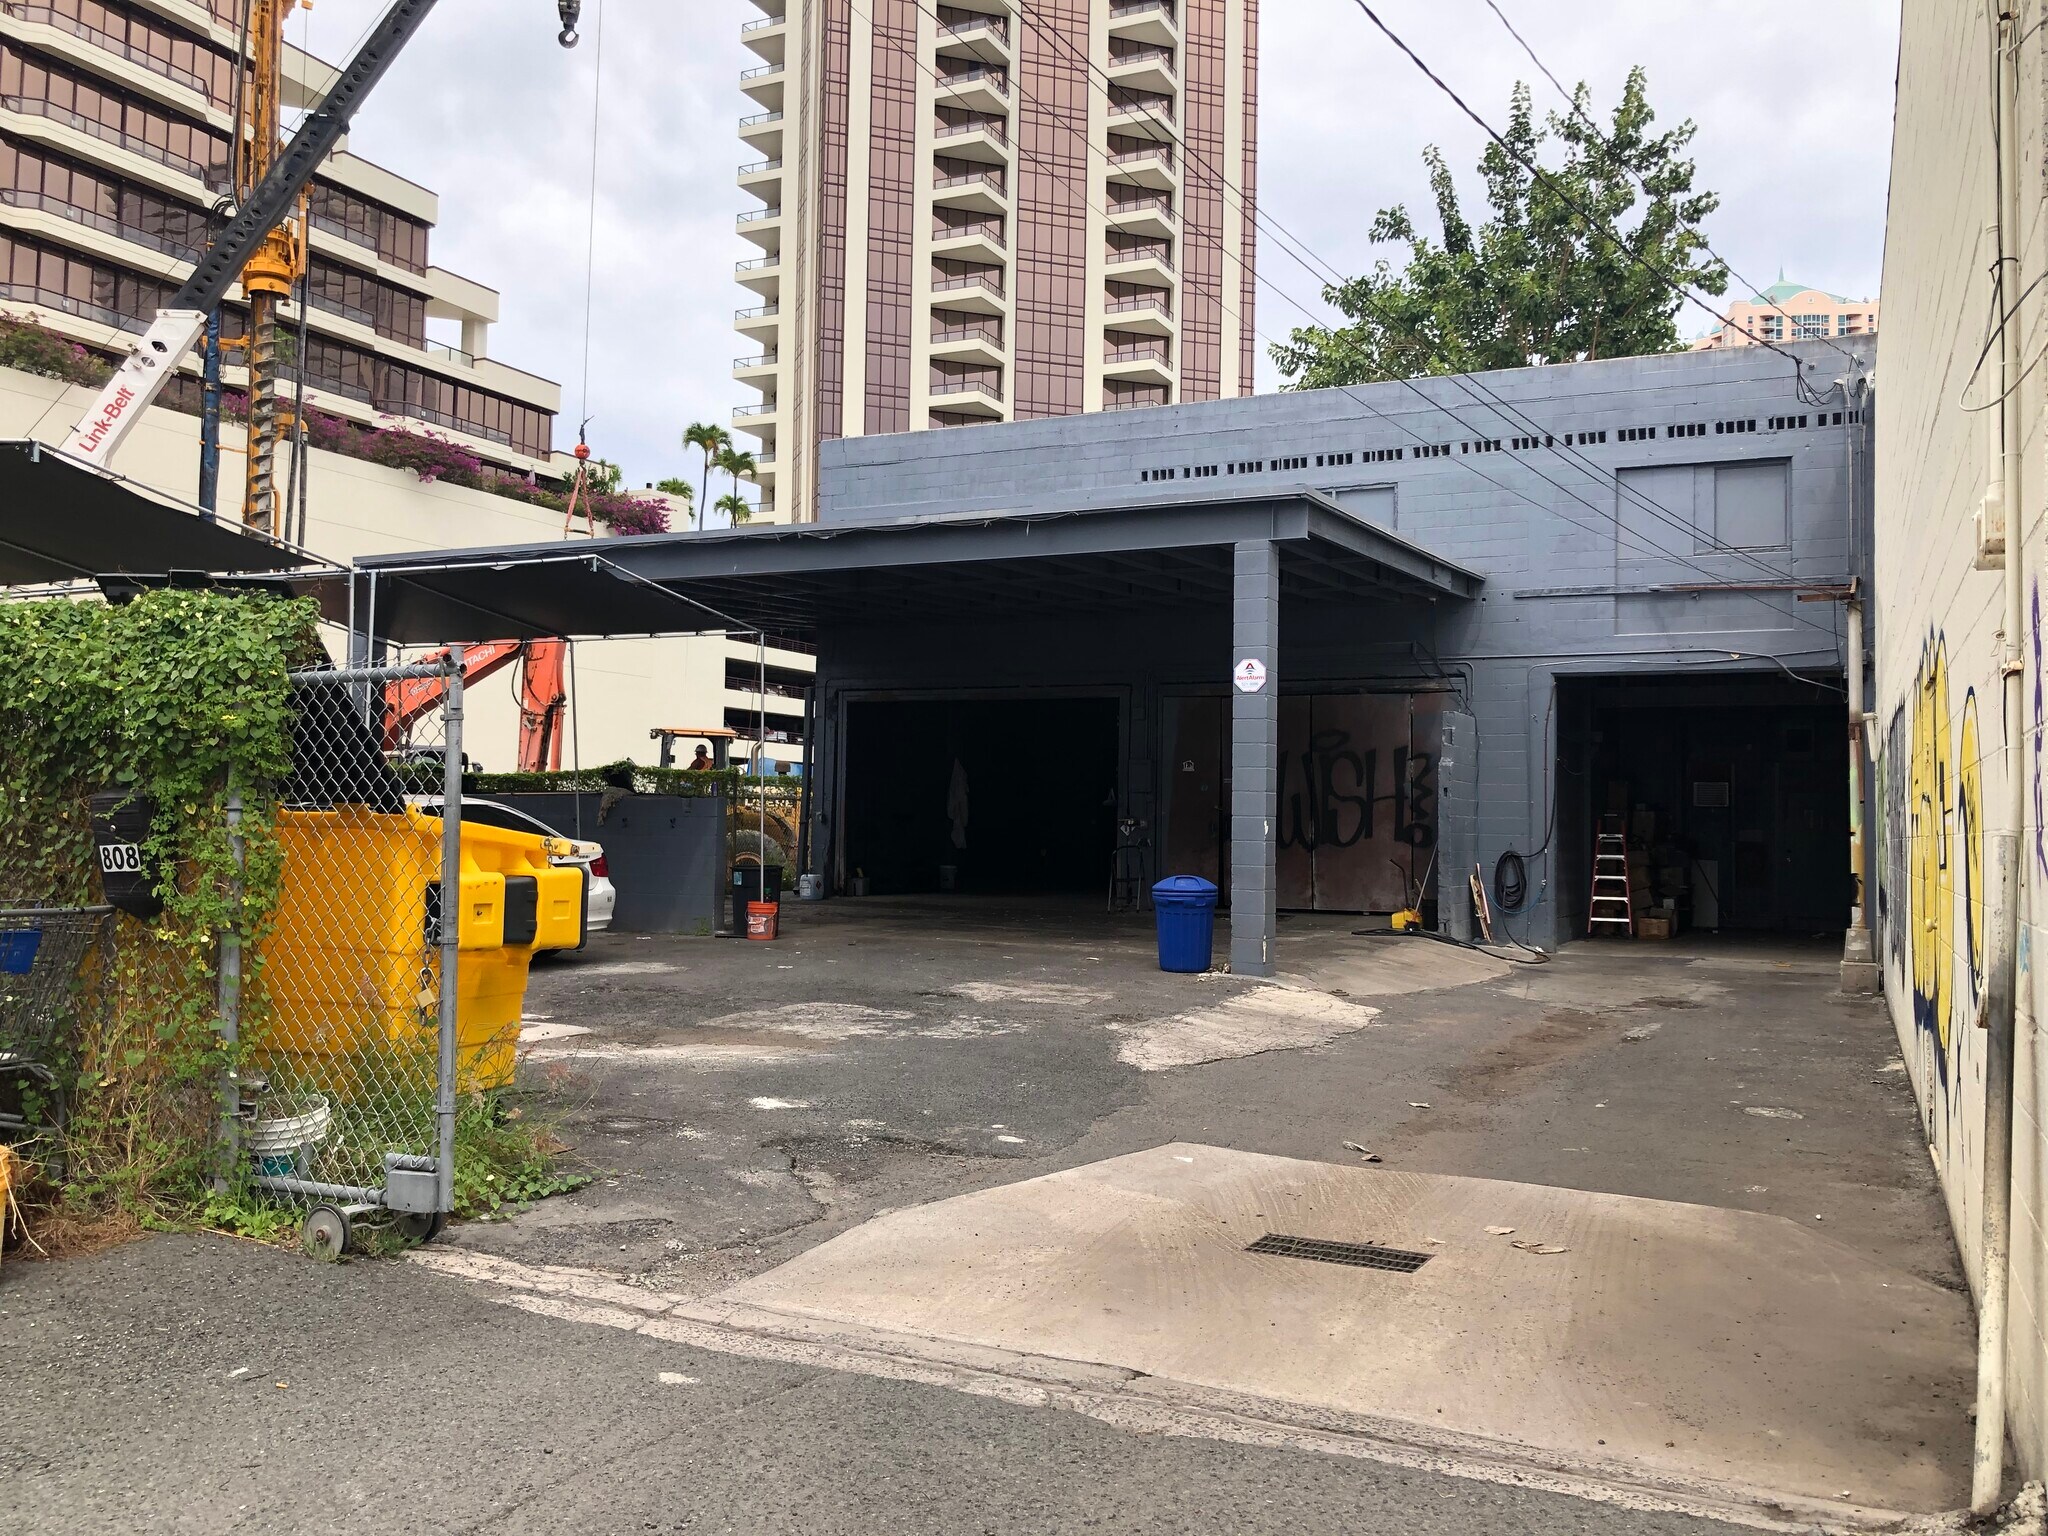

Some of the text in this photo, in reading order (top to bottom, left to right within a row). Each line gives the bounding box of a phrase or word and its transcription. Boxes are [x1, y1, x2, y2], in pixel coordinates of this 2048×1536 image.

[78, 385, 135, 452] Link-Belt
[463, 645, 496, 667] ITACHI
[102, 846, 139, 870] 808
